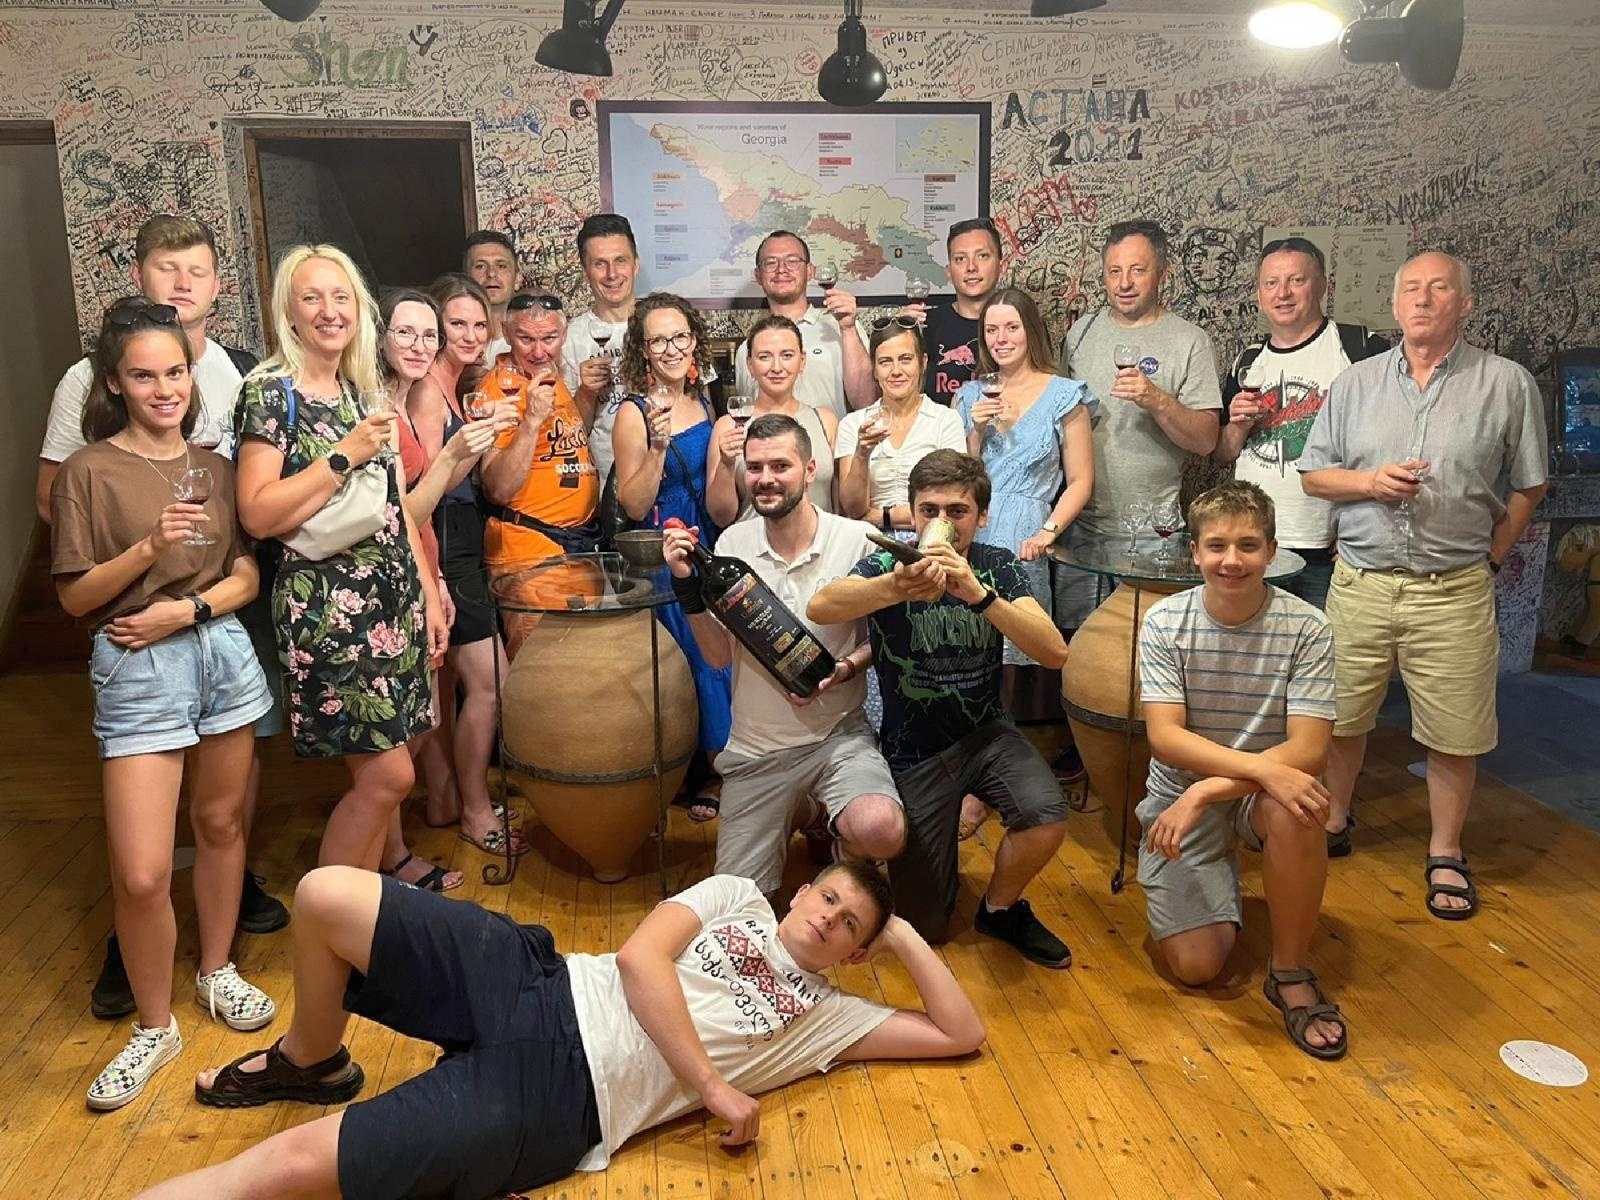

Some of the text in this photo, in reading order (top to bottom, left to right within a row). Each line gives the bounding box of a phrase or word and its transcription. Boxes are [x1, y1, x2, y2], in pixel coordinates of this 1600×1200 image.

[882, 30, 926, 49] ПРИВЕТ
[1002, 88, 1150, 130] АСТАНА
[741, 133, 787, 146] Georgia
[1048, 127, 1143, 166] 2021
